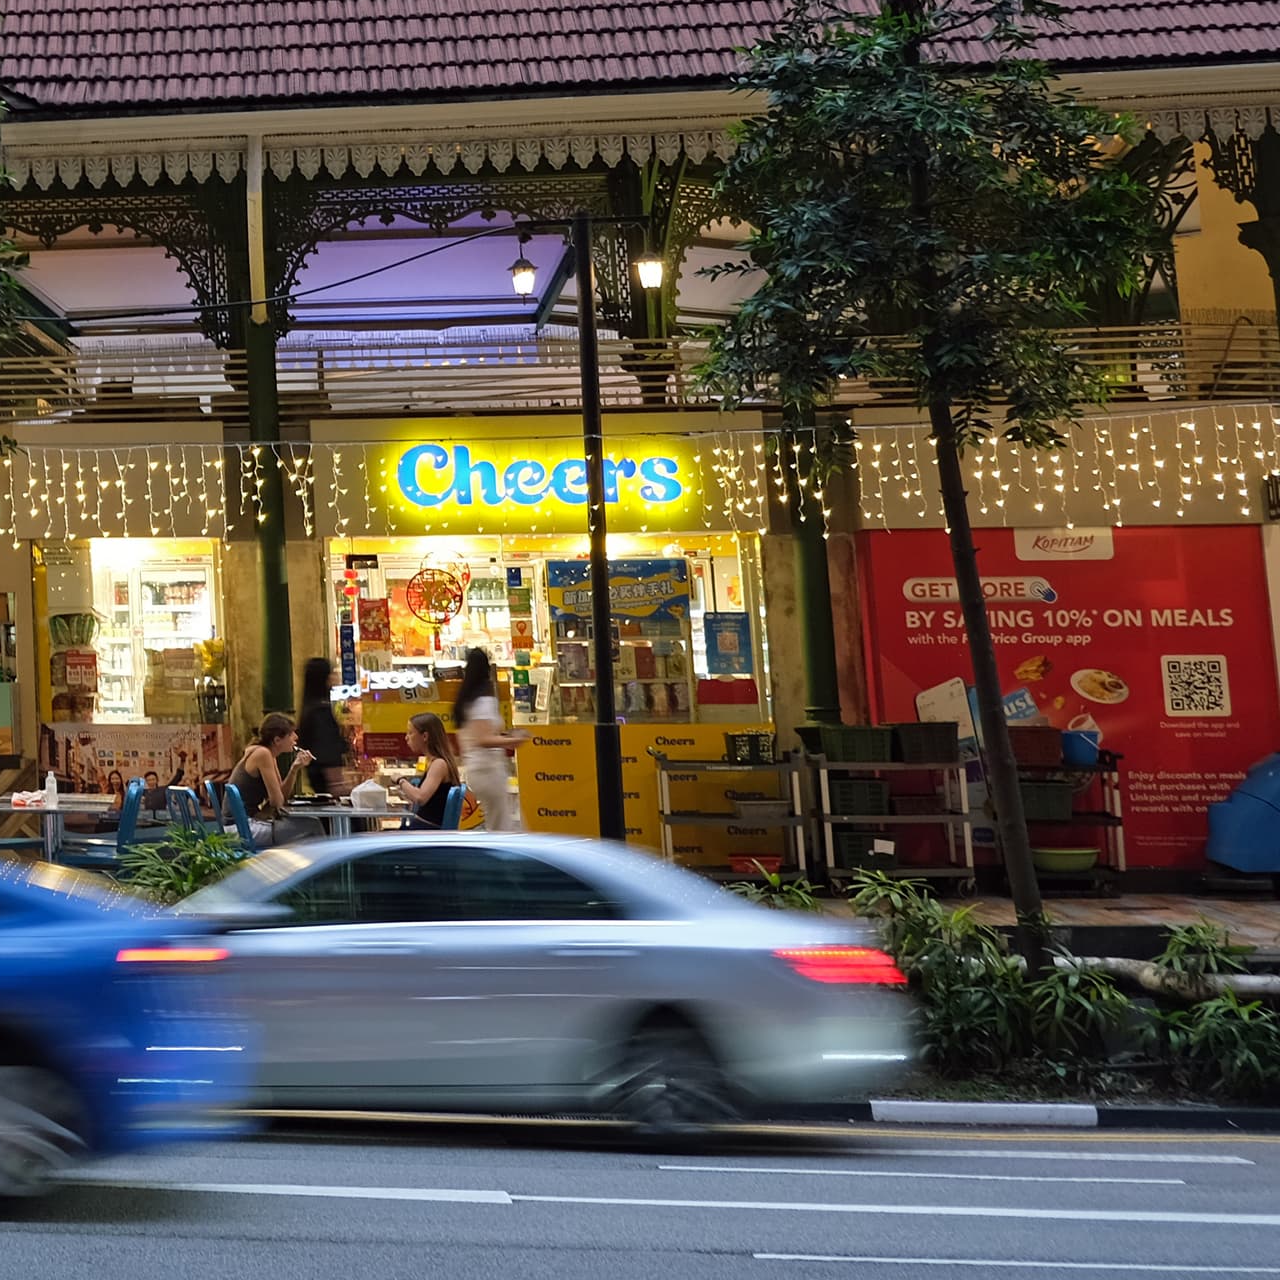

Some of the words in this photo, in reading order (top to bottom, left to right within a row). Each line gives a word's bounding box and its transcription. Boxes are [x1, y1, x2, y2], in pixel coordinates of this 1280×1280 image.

[397, 444, 683, 506] Cheers
[1032, 534, 1094, 550] KOPITIAM
[911, 583, 953, 598] GET
[983, 582, 1026, 598] ORE
[905, 611, 936, 628] BY
[943, 610, 1034, 628] SAING
[1103, 609, 1143, 627] ON
[1151, 608, 1234, 627] MEALS
[907, 633, 936, 645] with
[937, 633, 958, 645] the
[1022, 632, 1063, 646] Group
[1066, 634, 1092, 646] app
[1002, 692, 1035, 717] ust
[533, 736, 572, 747] Cheers
[655, 736, 695, 747] Cheers
[621, 754, 638, 764] ers
[535, 772, 574, 782] Cheers
[668, 773, 698, 782] heers
[1128, 771, 1154, 781] Enjoy
[1157, 771, 1202, 780] discounts
[1160, 783, 1207, 792] purchases
[1209, 782, 1231, 790] with
[623, 791, 641, 800] ers
[1181, 793, 1199, 801] and
[537, 807, 577, 817] Cheers
[1131, 804, 1170, 812] rewards
[1171, 804, 1193, 812] with
[625, 826, 643, 836] ers
[727, 825, 768, 836] Cheers
